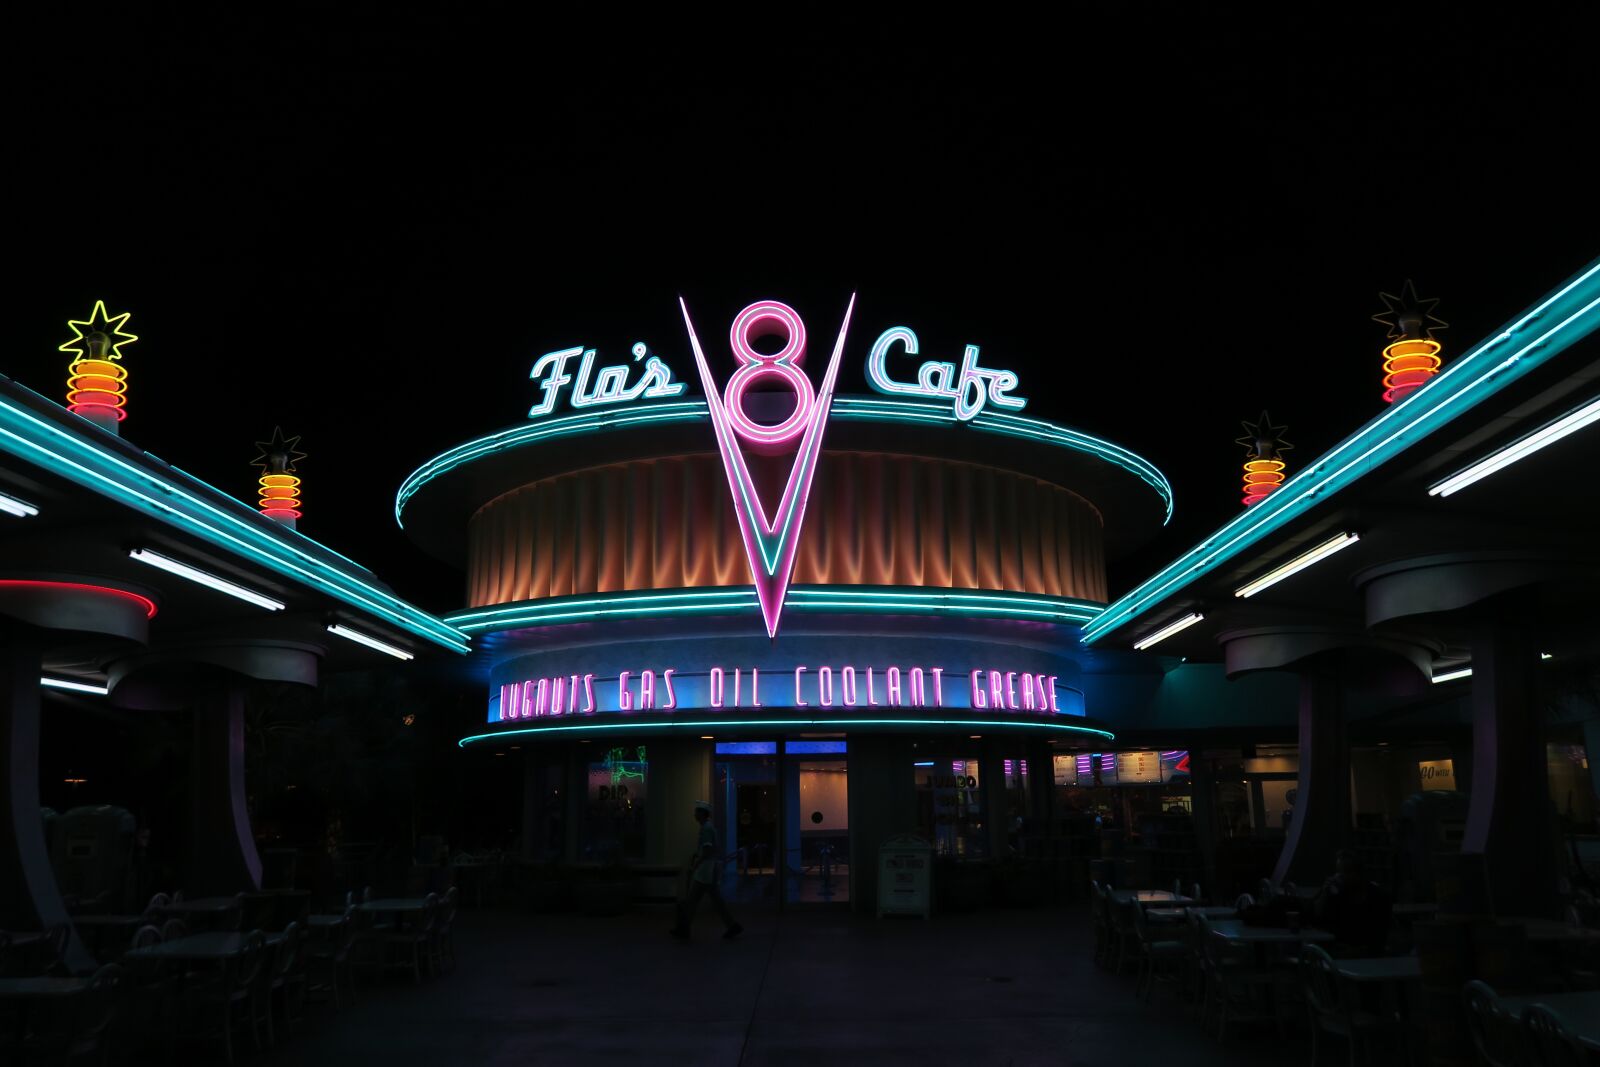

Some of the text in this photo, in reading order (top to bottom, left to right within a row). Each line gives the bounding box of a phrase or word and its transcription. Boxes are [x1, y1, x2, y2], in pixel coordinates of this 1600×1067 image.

[864, 325, 1028, 421] Cafe
[499, 666, 1062, 721] LUGNUTS GAS OIL COOLANT GREASE
